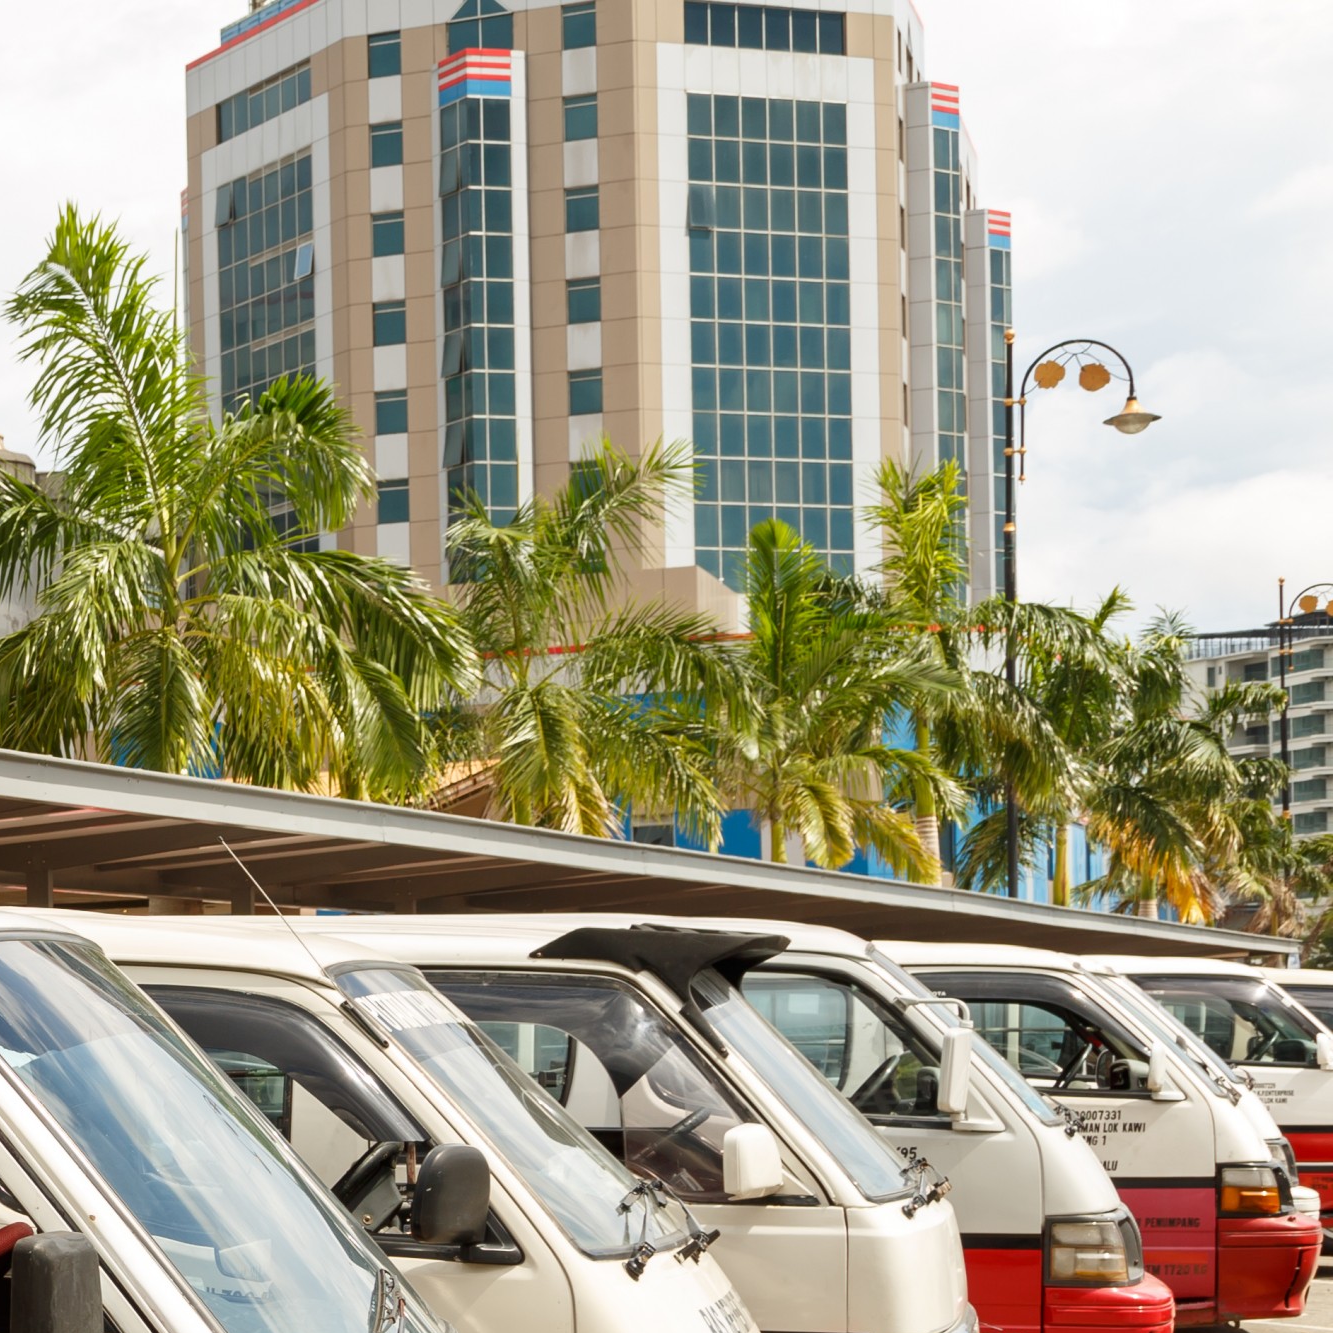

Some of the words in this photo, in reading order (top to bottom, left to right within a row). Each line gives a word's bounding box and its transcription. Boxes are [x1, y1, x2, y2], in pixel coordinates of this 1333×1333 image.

[1075, 1110, 1122, 1120] 0007331
[1103, 1123, 1118, 1133] LOK
[1122, 1123, 1146, 1133] KAWI
[1145, 1217, 1201, 1228] PENUMPANG
